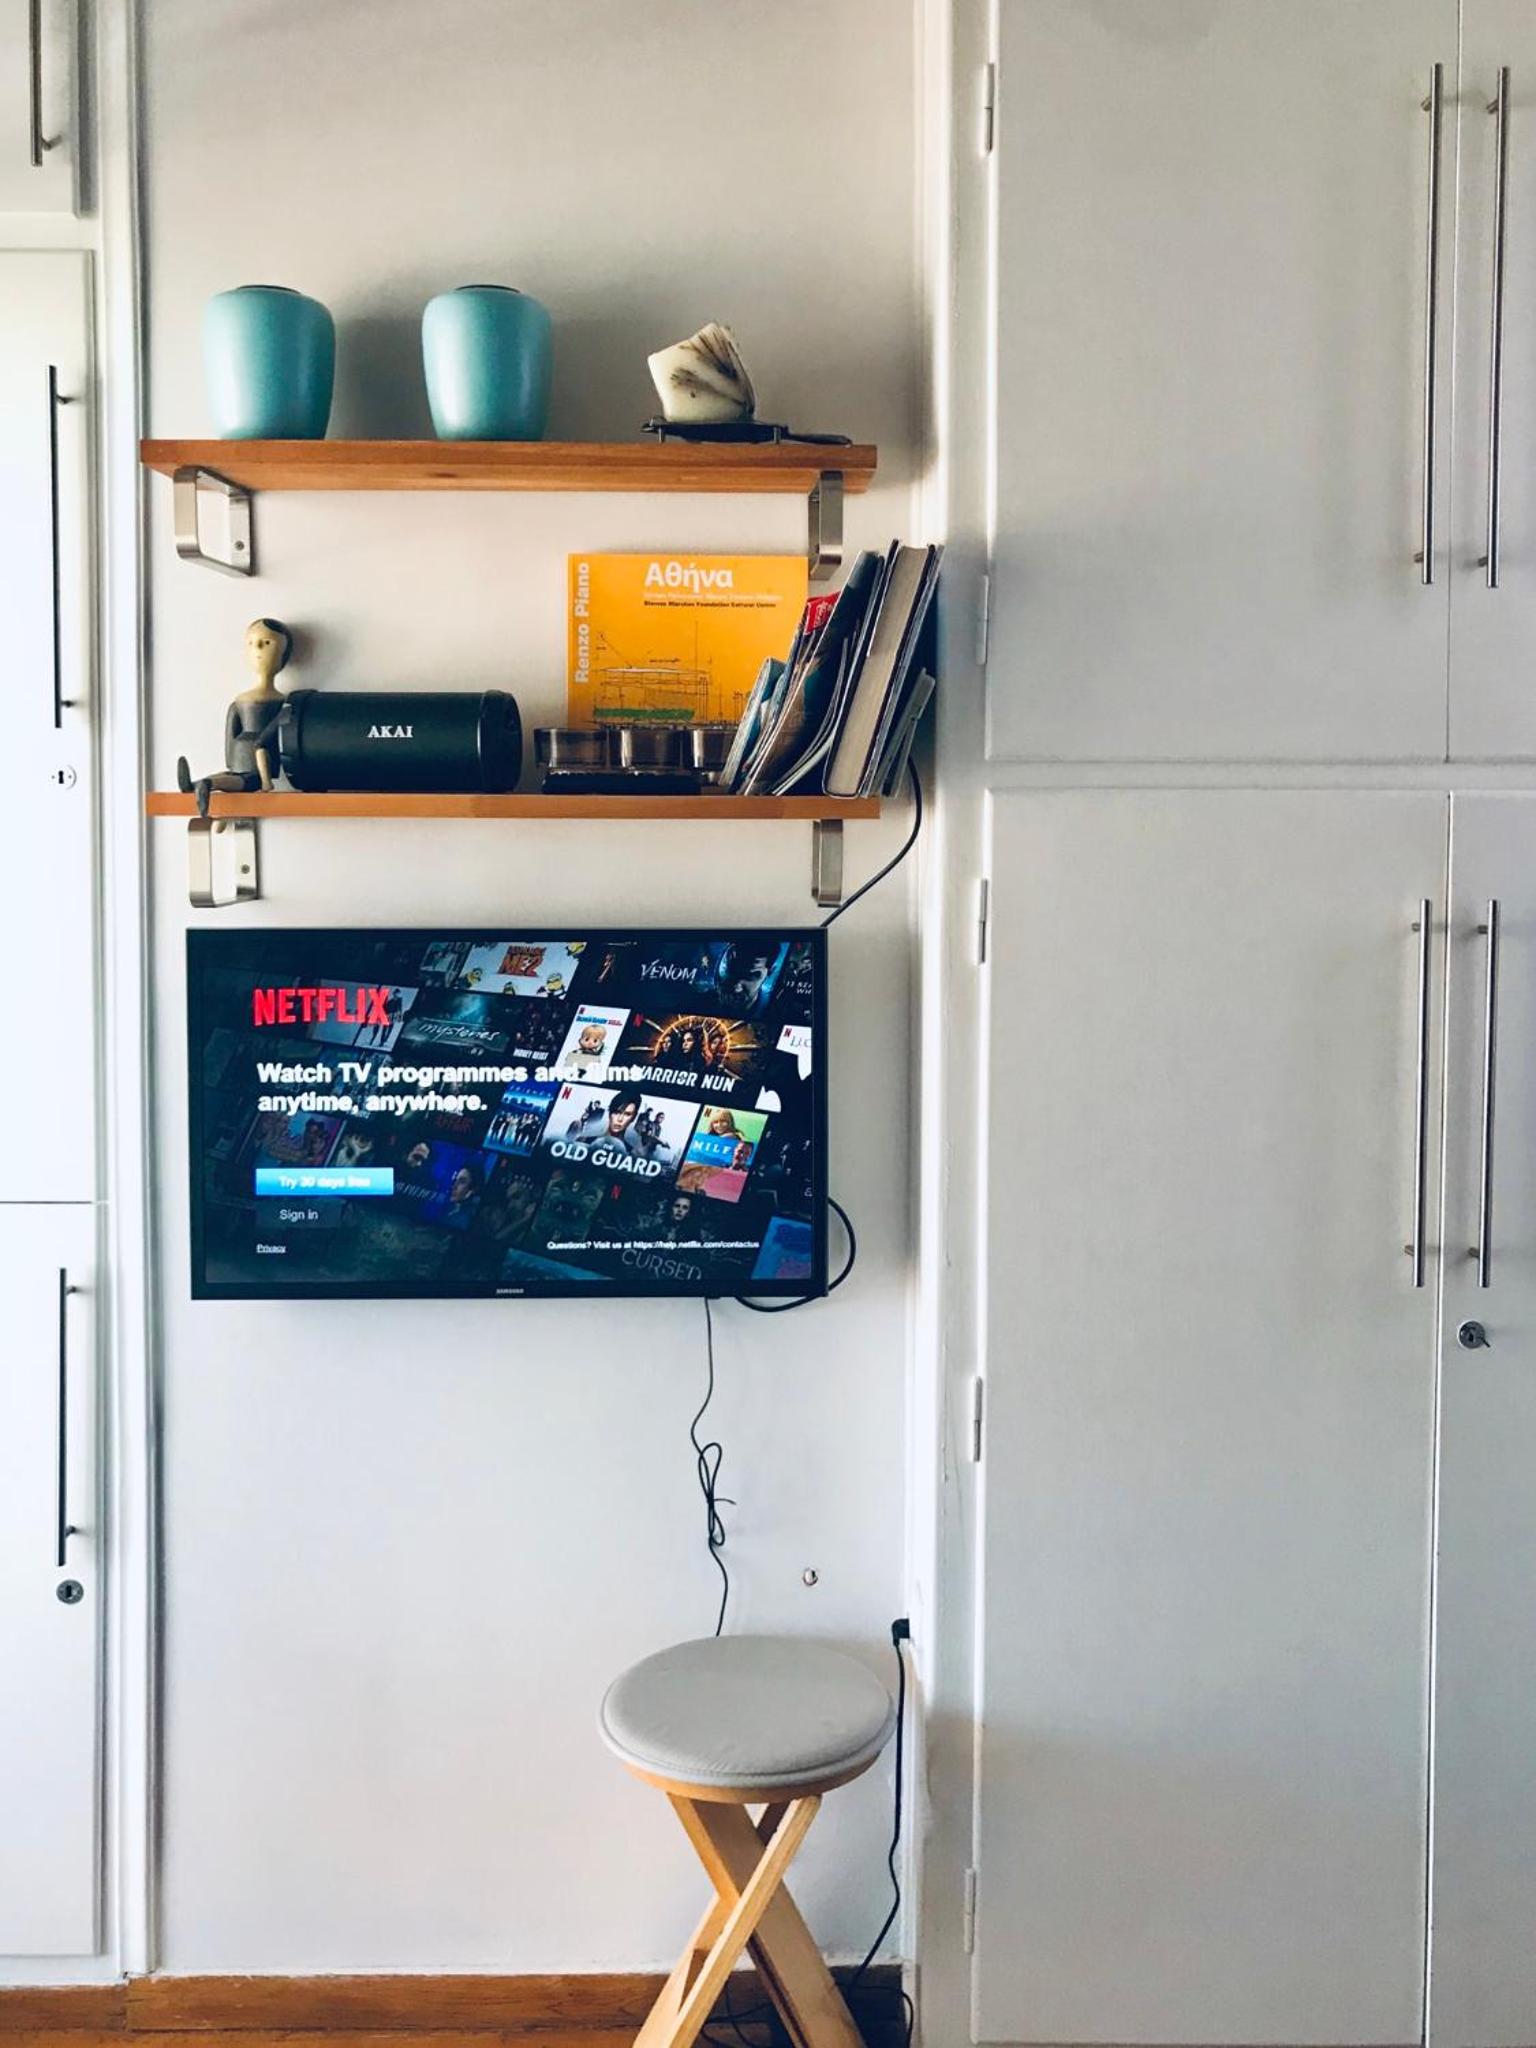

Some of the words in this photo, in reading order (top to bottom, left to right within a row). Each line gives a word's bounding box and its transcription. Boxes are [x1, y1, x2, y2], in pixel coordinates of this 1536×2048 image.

[574, 562, 590, 617] Piano
[644, 560, 733, 593] Αθήνα
[574, 624, 590, 683] Renzo
[367, 725, 414, 738] AKAI
[640, 959, 698, 985] VENOM
[254, 987, 390, 1027] NETFLIX
[419, 1022, 500, 1042] mysteries
[257, 1062, 332, 1083] Watch
[337, 1063, 372, 1083] TV
[377, 1063, 528, 1088] programmes
[534, 1062, 579, 1082] and
[700, 1074, 736, 1093] NUN
[257, 1090, 359, 1116] anytime,
[366, 1089, 488, 1115] anywhere.
[550, 1140, 588, 1161] OLD
[591, 1149, 662, 1177] GUARD
[694, 1140, 732, 1155] MILF
[279, 1175, 297, 1189] Try
[279, 1209, 305, 1222] Sign
[307, 1209, 319, 1220] in
[547, 1240, 592, 1250] Questions?
[593, 1240, 611, 1249] Visit
